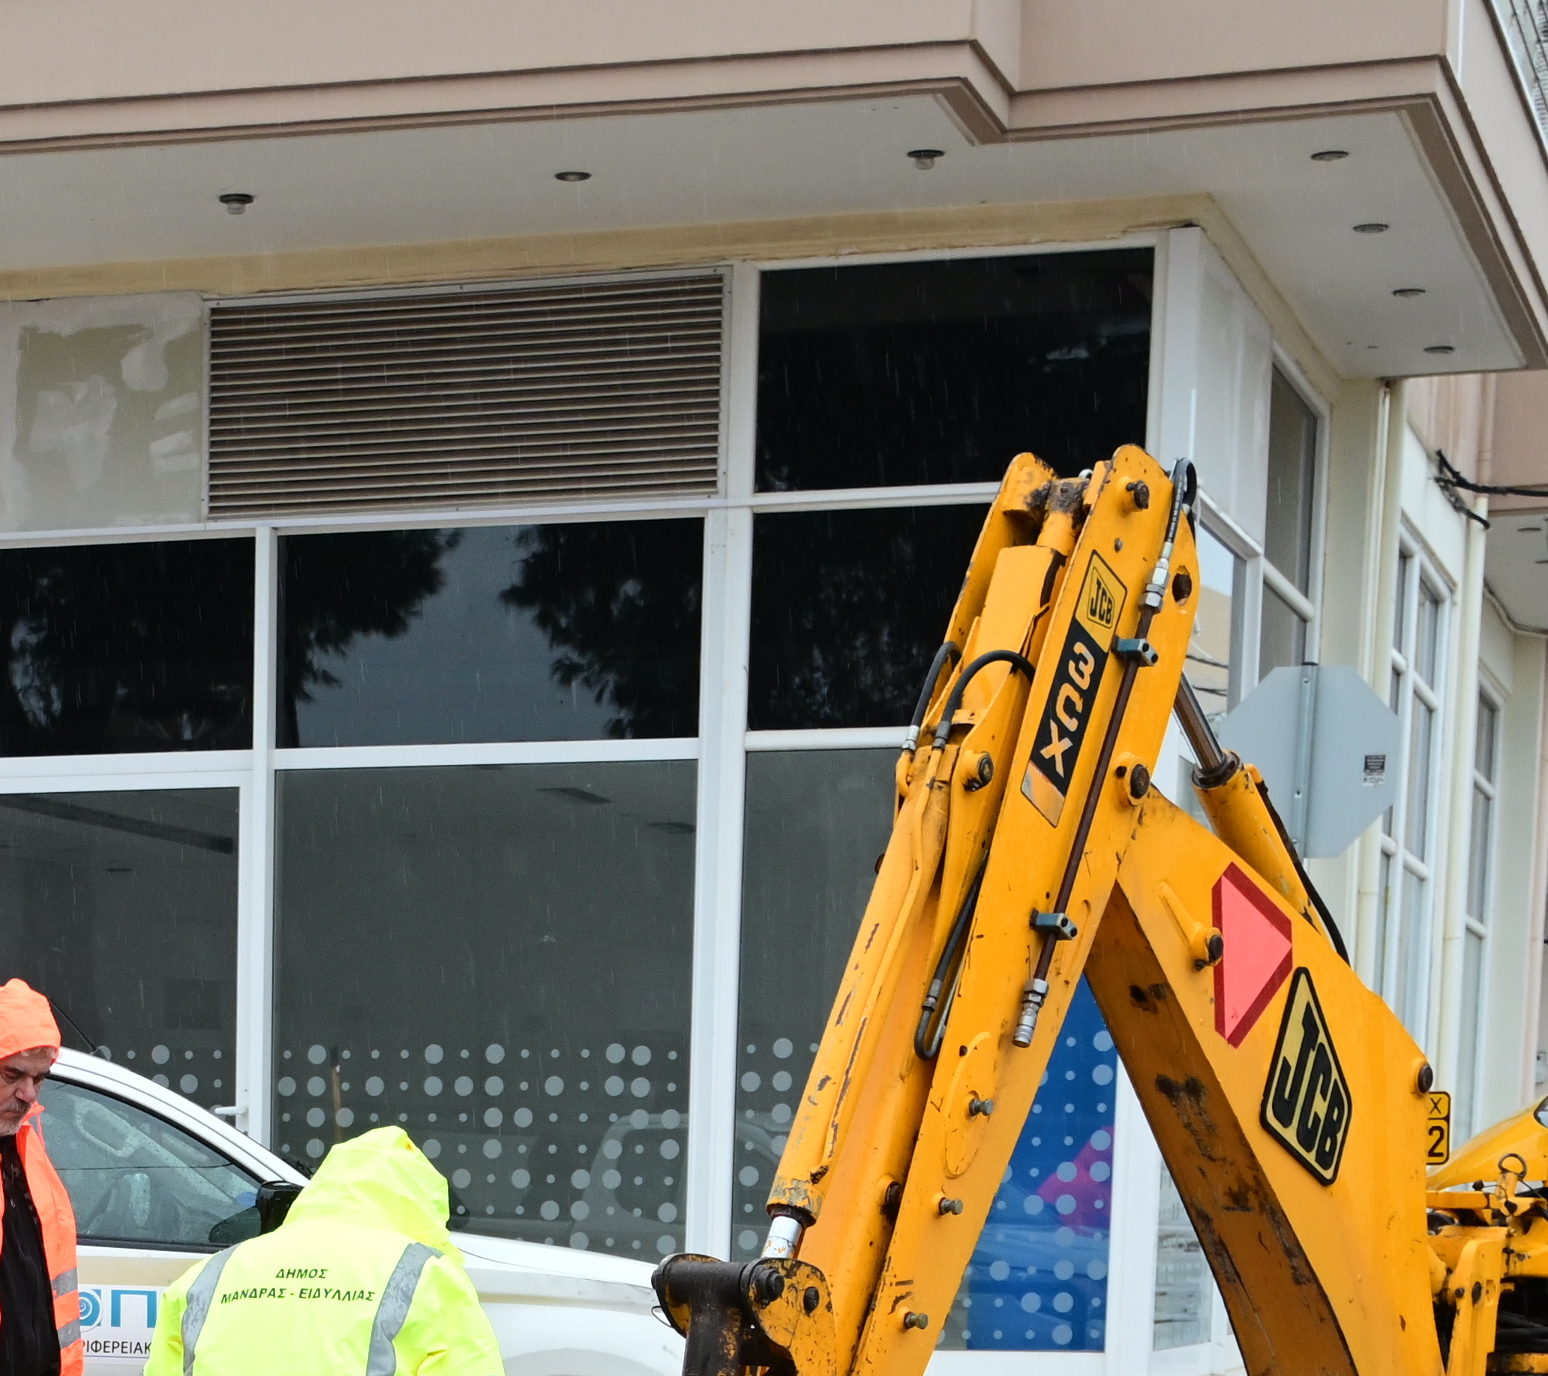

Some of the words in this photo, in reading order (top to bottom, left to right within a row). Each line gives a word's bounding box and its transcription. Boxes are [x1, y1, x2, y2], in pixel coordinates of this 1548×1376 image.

[1090, 578, 1114, 624] JCB
[1040, 641, 1095, 778] 3CX
[1271, 1001, 1346, 1171] JCB
[1427, 1125, 1445, 1158] 2
[275, 1268, 329, 1280] ΔΗΜΟΣ
[220, 1287, 287, 1305] ΜΑΝΔΡΑΣ
[298, 1287, 377, 1302] ΕΙΔΥΛΛΙΑΣ
